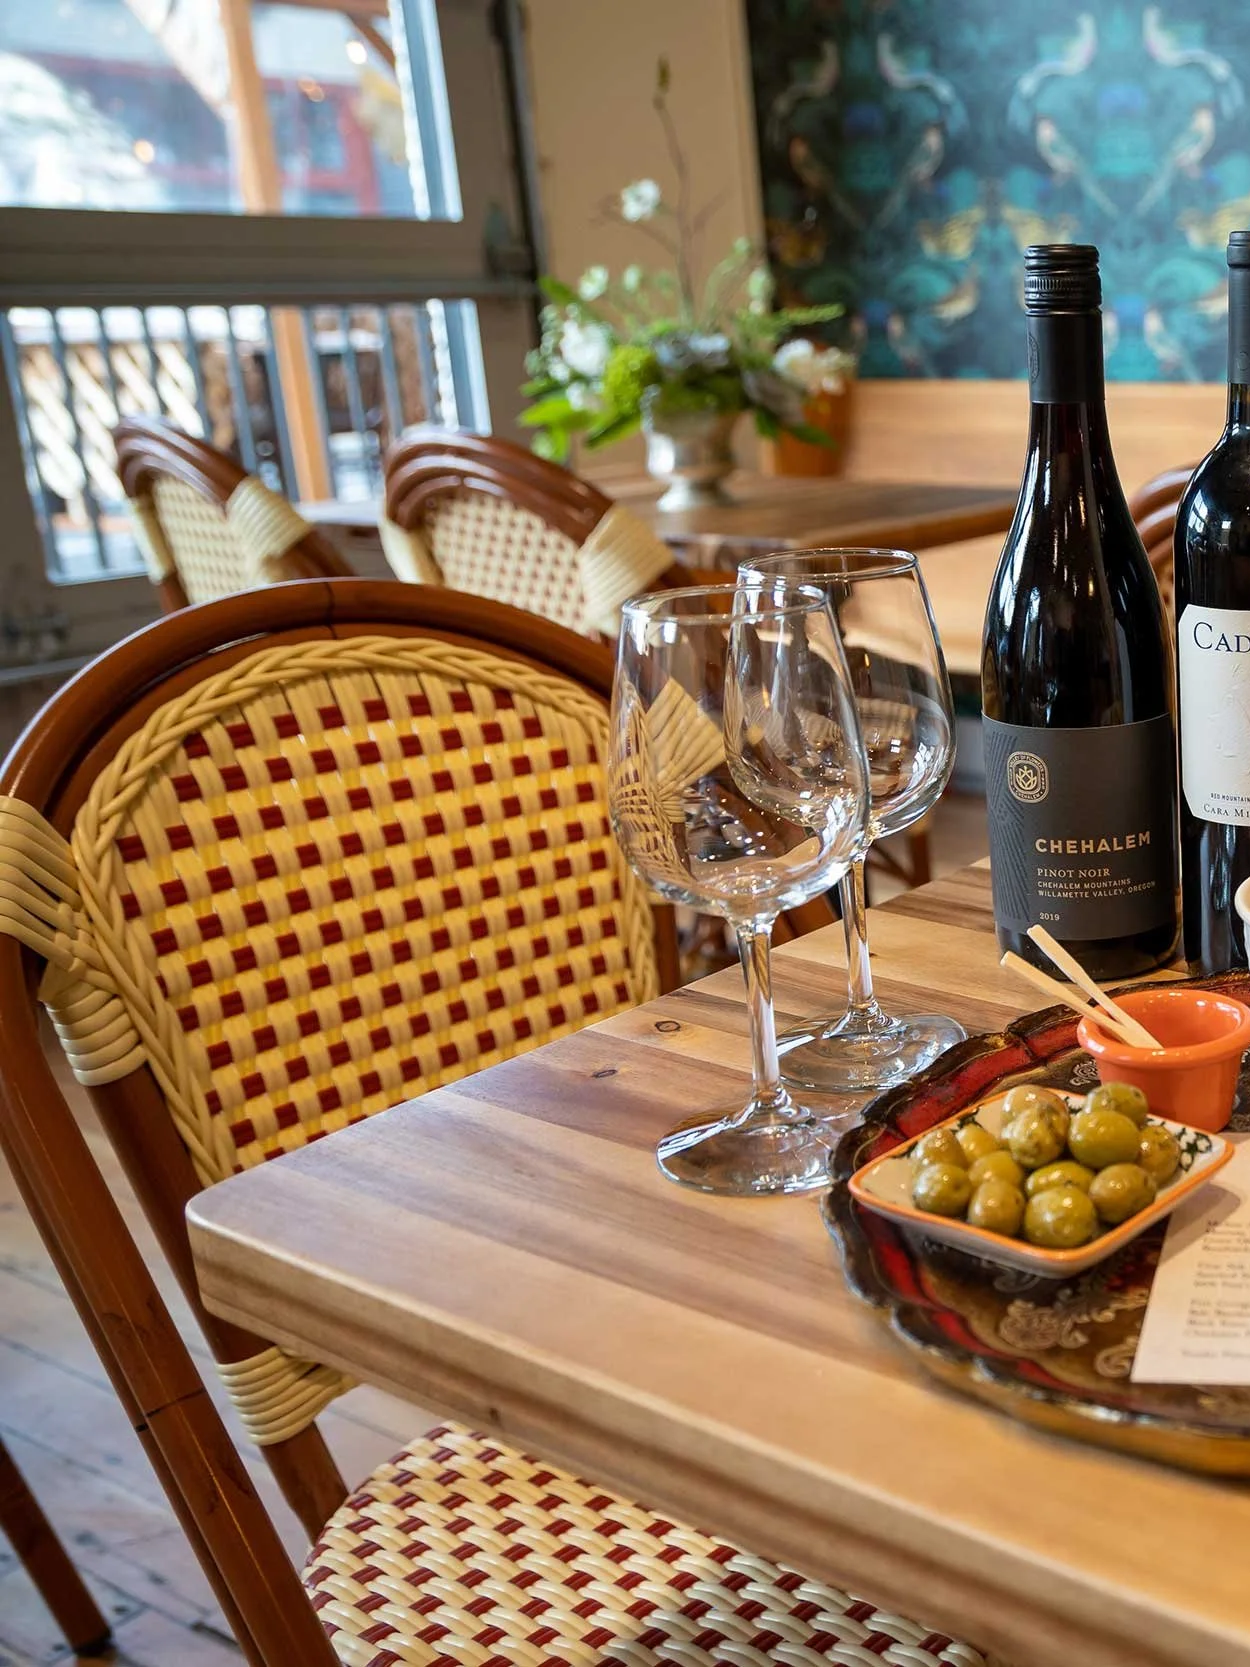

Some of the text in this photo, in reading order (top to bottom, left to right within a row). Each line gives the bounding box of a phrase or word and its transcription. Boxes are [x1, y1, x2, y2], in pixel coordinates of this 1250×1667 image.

[1221, 794, 1250, 802] MOUNTAIN
[1203, 804, 1229, 817] CARA
[1035, 831, 1151, 854] CHEHALEM
[1037, 868, 1111, 878] PINOT NOIR
[1037, 878, 1131, 890] CHEHALEM MOUNTAINS
[1038, 881, 1156, 898] WILLAMETTE VALLEY, OREGON
[1039, 912, 1060, 921] 2019
